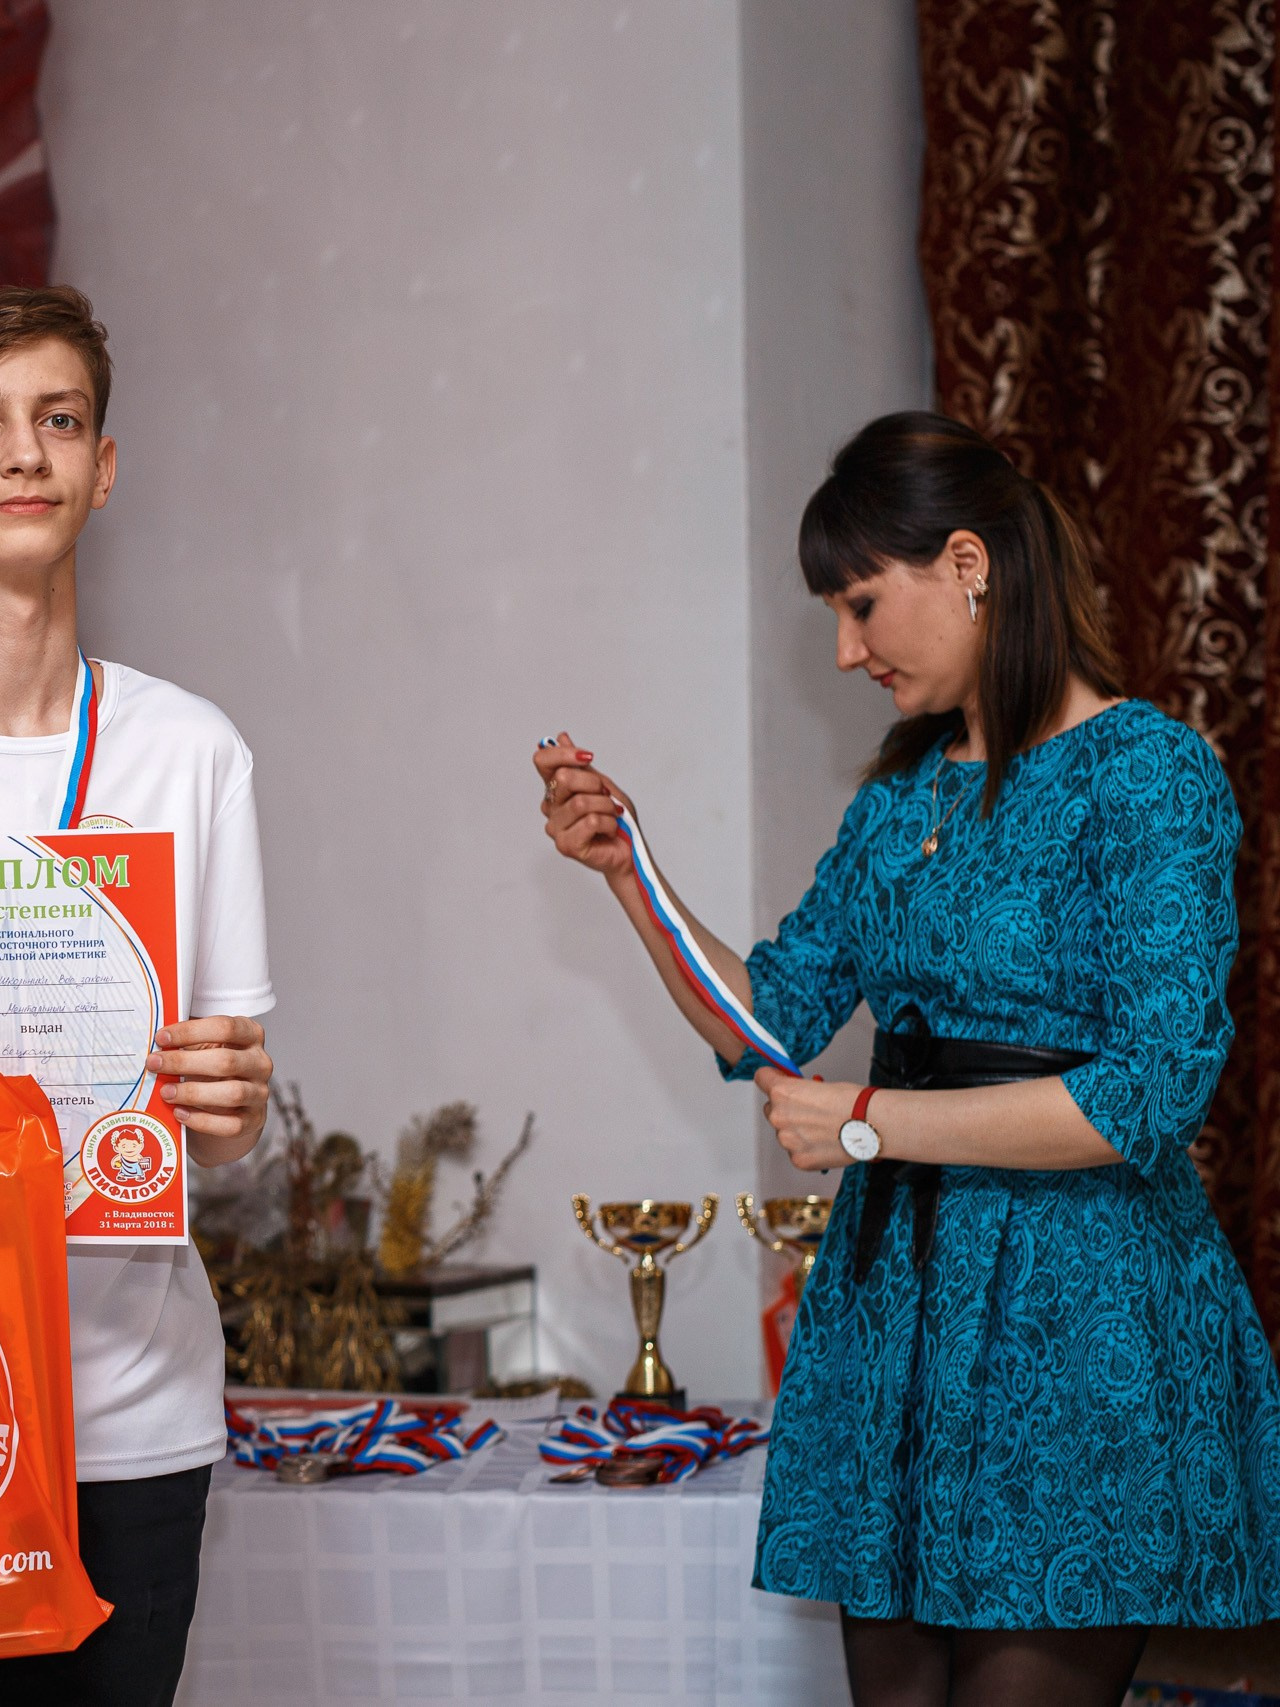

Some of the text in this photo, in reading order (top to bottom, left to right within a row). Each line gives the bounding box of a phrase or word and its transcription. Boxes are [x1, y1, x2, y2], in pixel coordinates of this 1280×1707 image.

[60, 939, 105, 949] ТУРНИРА
[38, 950, 107, 961] АРИФМЕТИКЕ
[20, 1024, 63, 1036] выдан
[49, 1096, 95, 1106] ватель
[86, 1116, 173, 1158] ЦЕНТР РАЗВИТИЯ ИНТЕЛЛЕКТА
[87, 1166, 174, 1199] ПИФАГОРКА
[112, 1210, 175, 1219] Владивосток
[99, 1220, 175, 1230] 31 марта 2018 г.
